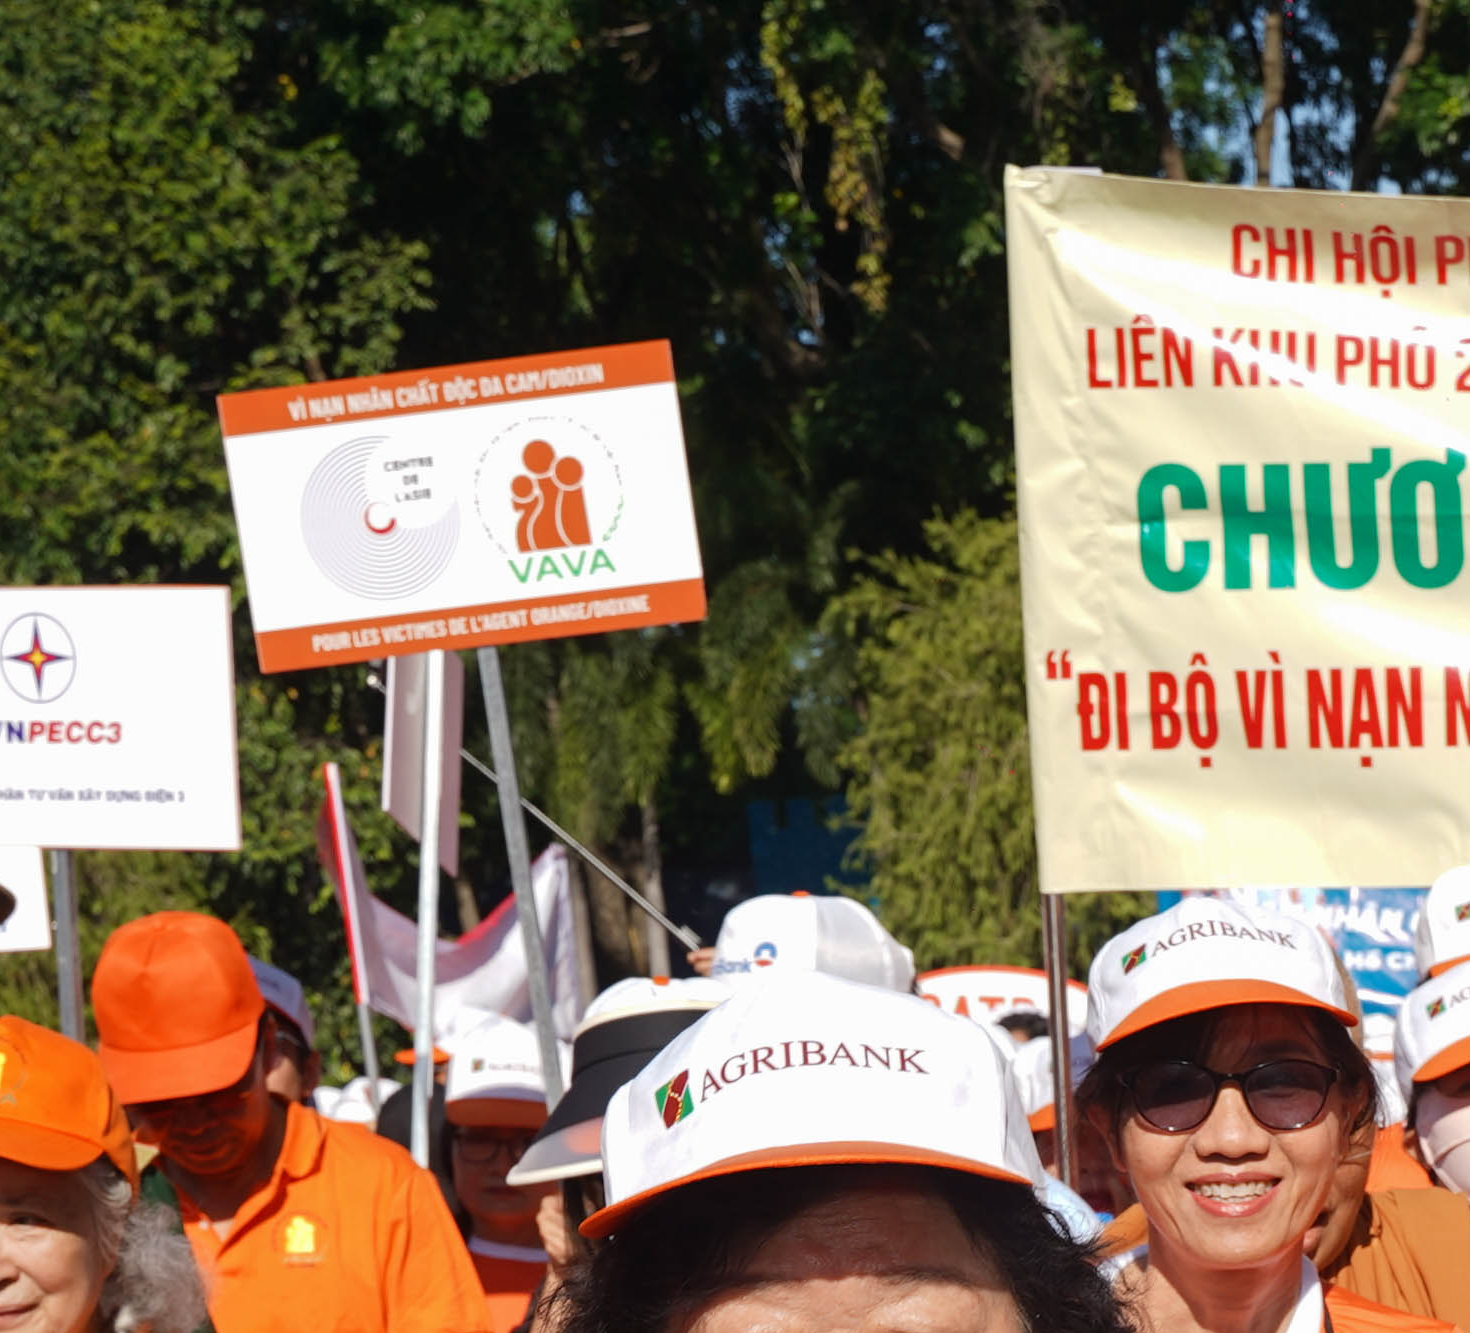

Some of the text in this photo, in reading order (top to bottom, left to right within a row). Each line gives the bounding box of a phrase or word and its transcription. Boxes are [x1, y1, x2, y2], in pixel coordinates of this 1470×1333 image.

[1231, 223, 1314, 283] CHI
[1333, 225, 1417, 298] HỘI
[1085, 314, 1193, 388] LIÊN
[506, 363, 604, 394] CAM/DIOXIN
[508, 548, 616, 584] VAVA
[312, 632, 351, 652] POUR
[353, 628, 380, 647] LES
[381, 619, 447, 644] VICTIMES
[449, 617, 468, 635] DE
[1148, 652, 1219, 768] BỘ
[1236, 651, 1287, 750] VÌ
[1306, 666, 1424, 768] NẠN
[1150, 920, 1298, 956] AGRIBANK
[698, 1040, 928, 1103] AGRIBANK
